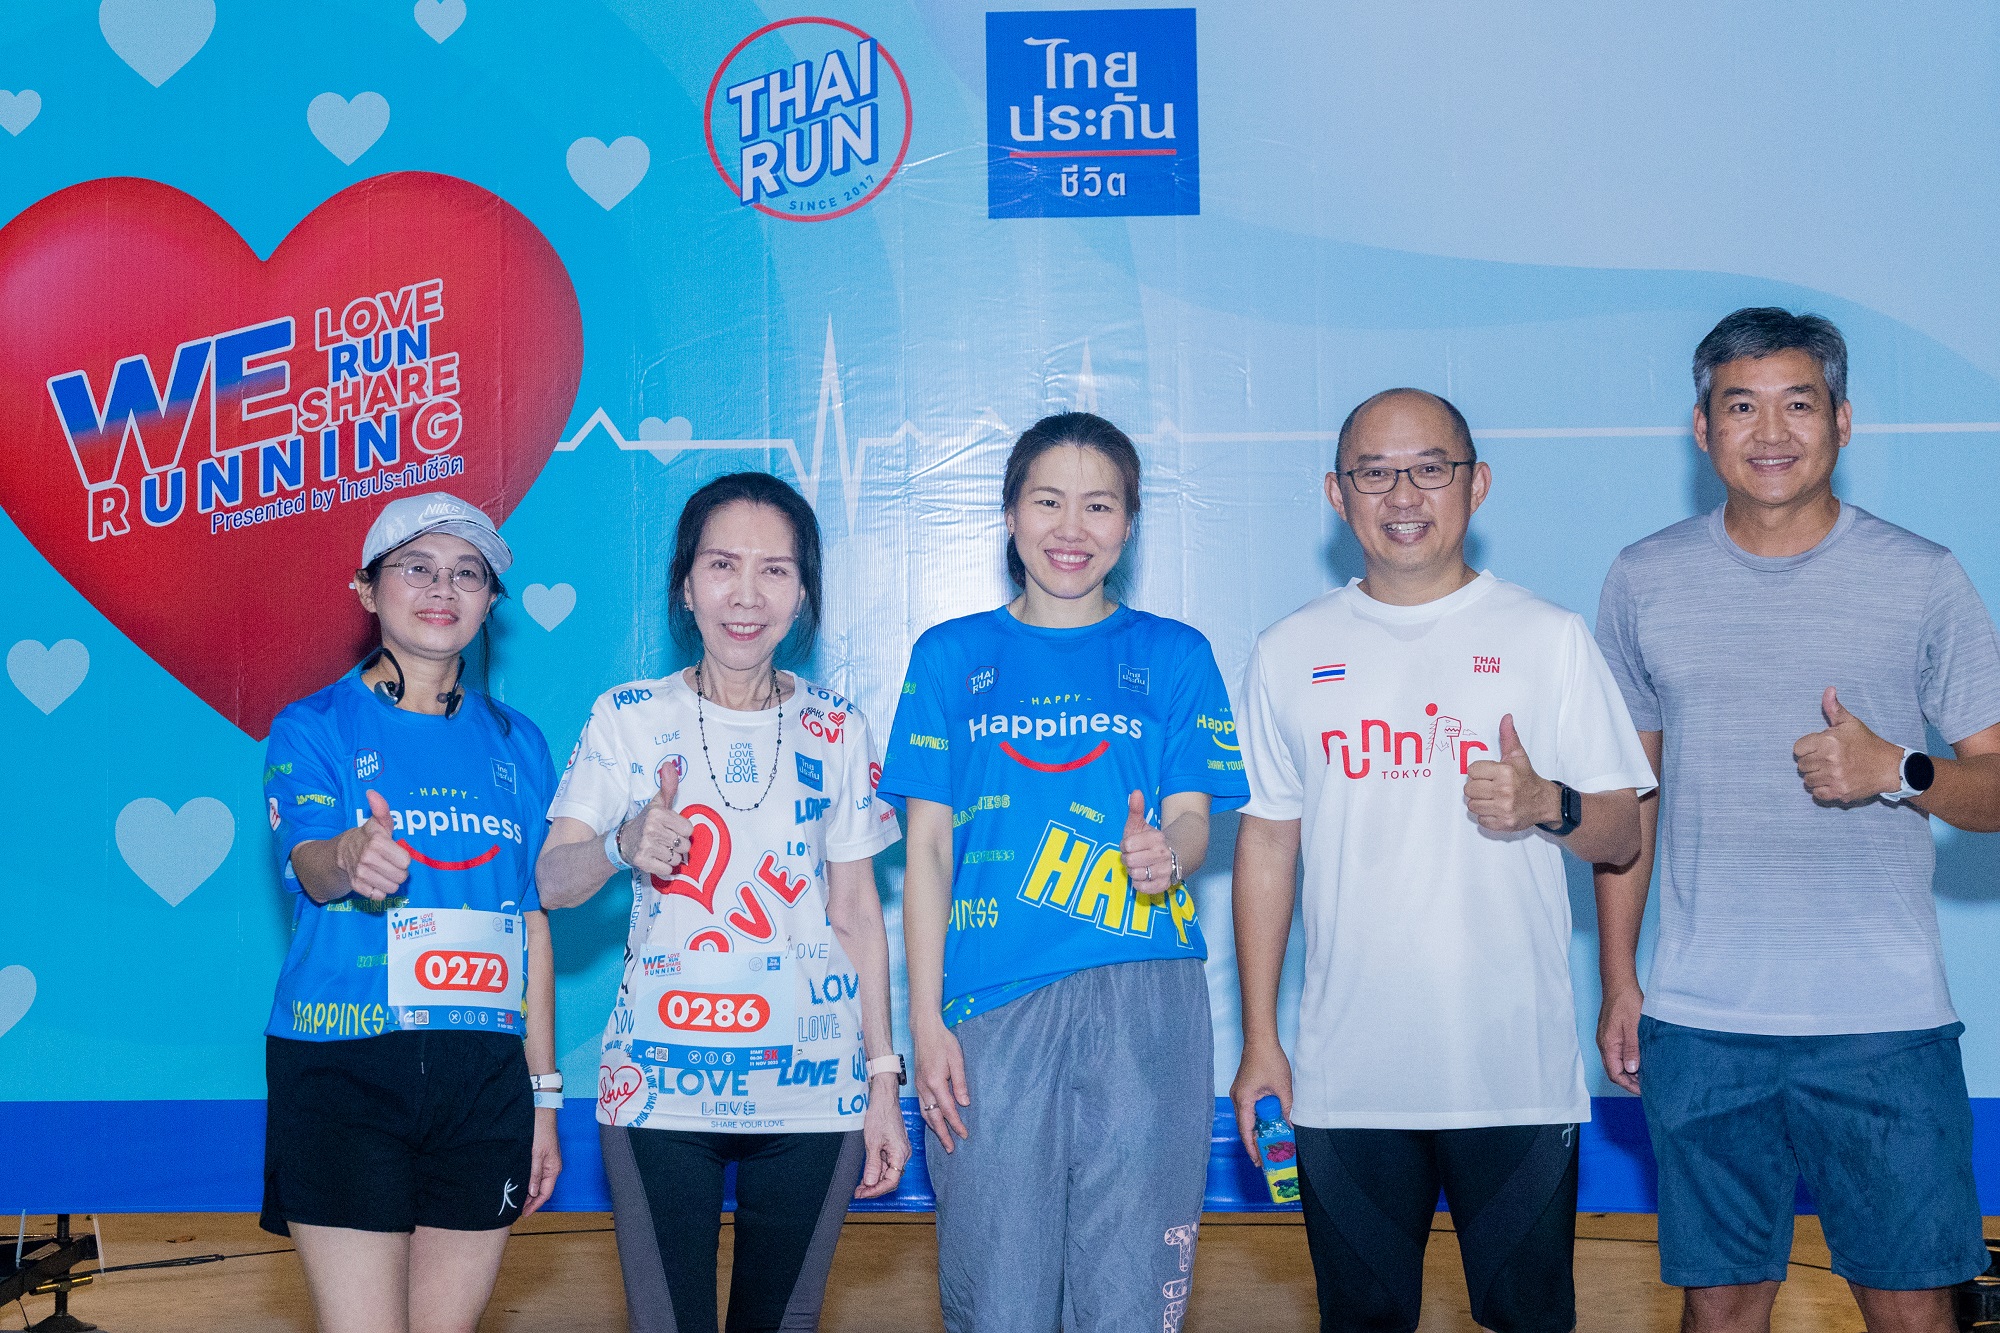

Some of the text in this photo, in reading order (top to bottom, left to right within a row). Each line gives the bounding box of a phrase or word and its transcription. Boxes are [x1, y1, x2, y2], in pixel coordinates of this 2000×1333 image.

[1023, 36, 1138, 89] ไทย
[726, 37, 878, 142] THAI
[1009, 92, 1177, 142] ประกัน
[739, 101, 879, 207] RUN
[1060, 164, 1127, 198] ชีวิต
[789, 174, 876, 212] SINCE 2017
[314, 277, 445, 352] LOVE
[328, 321, 431, 386] RUN
[297, 351, 461, 433] SHARE
[46, 315, 298, 491] WE
[87, 397, 463, 543] RUNNING
[210, 455, 464, 535] Presented by ไทยประกันชีวิต
[424, 502, 461, 516] NIKE
[1473, 656, 1501, 665] THAI
[1473, 664, 1500, 674] RUN
[970, 667, 995, 686] THAI
[972, 676, 994, 695] RUN
[807, 686, 856, 715] LOVE
[1031, 693, 1081, 706] HAPPY
[968, 711, 1143, 743] Happiness
[654, 729, 681, 746] LOVE
[730, 742, 753, 750] LOVE
[909, 732, 950, 752] HAPPINESS
[356, 751, 379, 769] THAI
[727, 758, 756, 767] LOVE
[729, 750, 754, 758] LOVE
[357, 761, 380, 779] RUN
[725, 773, 760, 784] LOVE
[726, 765, 758, 775] LOVE
[1382, 768, 1432, 780] TOKYO
[419, 786, 468, 800] HAPPY
[1069, 801, 1106, 824] HAPPINESS
[391, 916, 418, 935] WE
[395, 925, 437, 941] RUNNING
[424, 954, 503, 989] 0272
[642, 954, 666, 971] WE
[644, 965, 682, 977] RUNNING
[667, 994, 760, 1028] 0286
[797, 1012, 841, 1042] LOVE
[763, 1049, 779, 1061] 5K
[657, 1066, 750, 1098] LOVE
[776, 1057, 841, 1088] LOVE
[710, 1118, 786, 1129] SHARE YOUR LOVE
